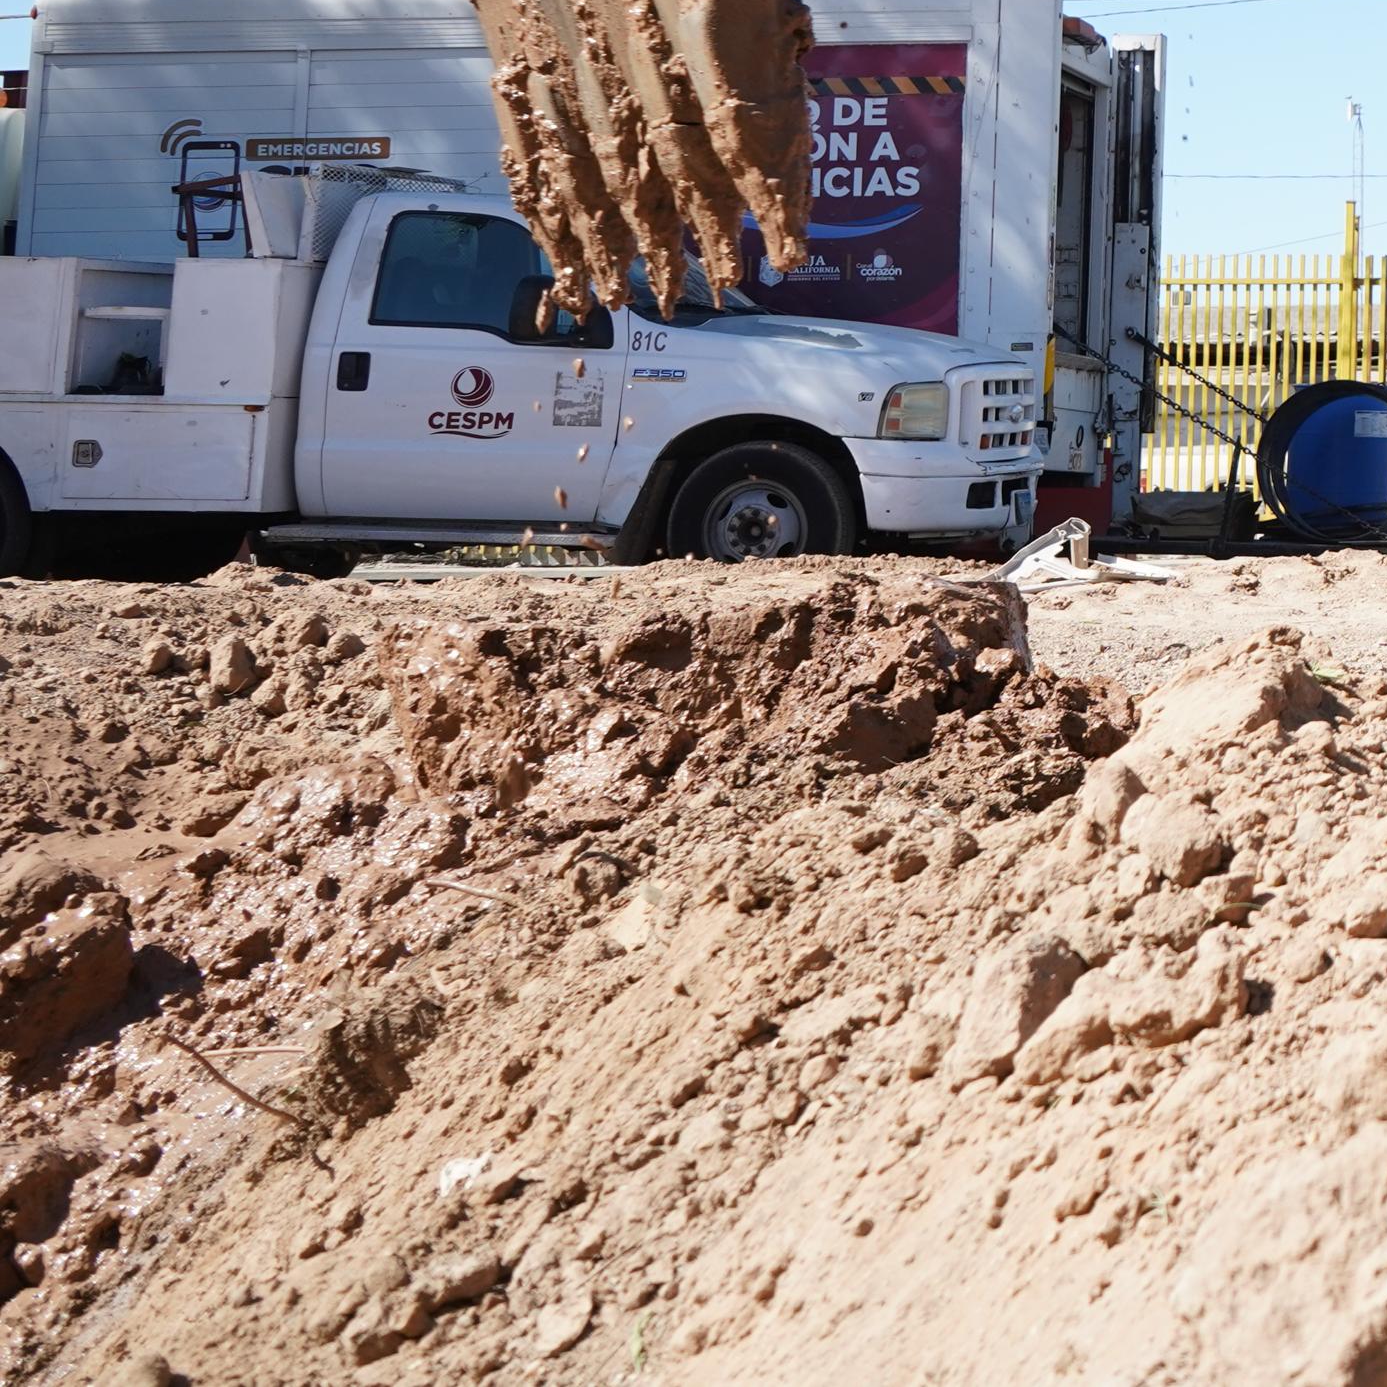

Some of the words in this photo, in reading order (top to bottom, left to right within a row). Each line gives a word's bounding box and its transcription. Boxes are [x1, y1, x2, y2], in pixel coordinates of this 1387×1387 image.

[833, 97, 888, 126] DE
[257, 142, 382, 157] EMERGENCIAS
[869, 131, 900, 161] A
[860, 265, 903, 276] corazón
[632, 331, 668, 352] 81C
[428, 411, 515, 430] CESPM
